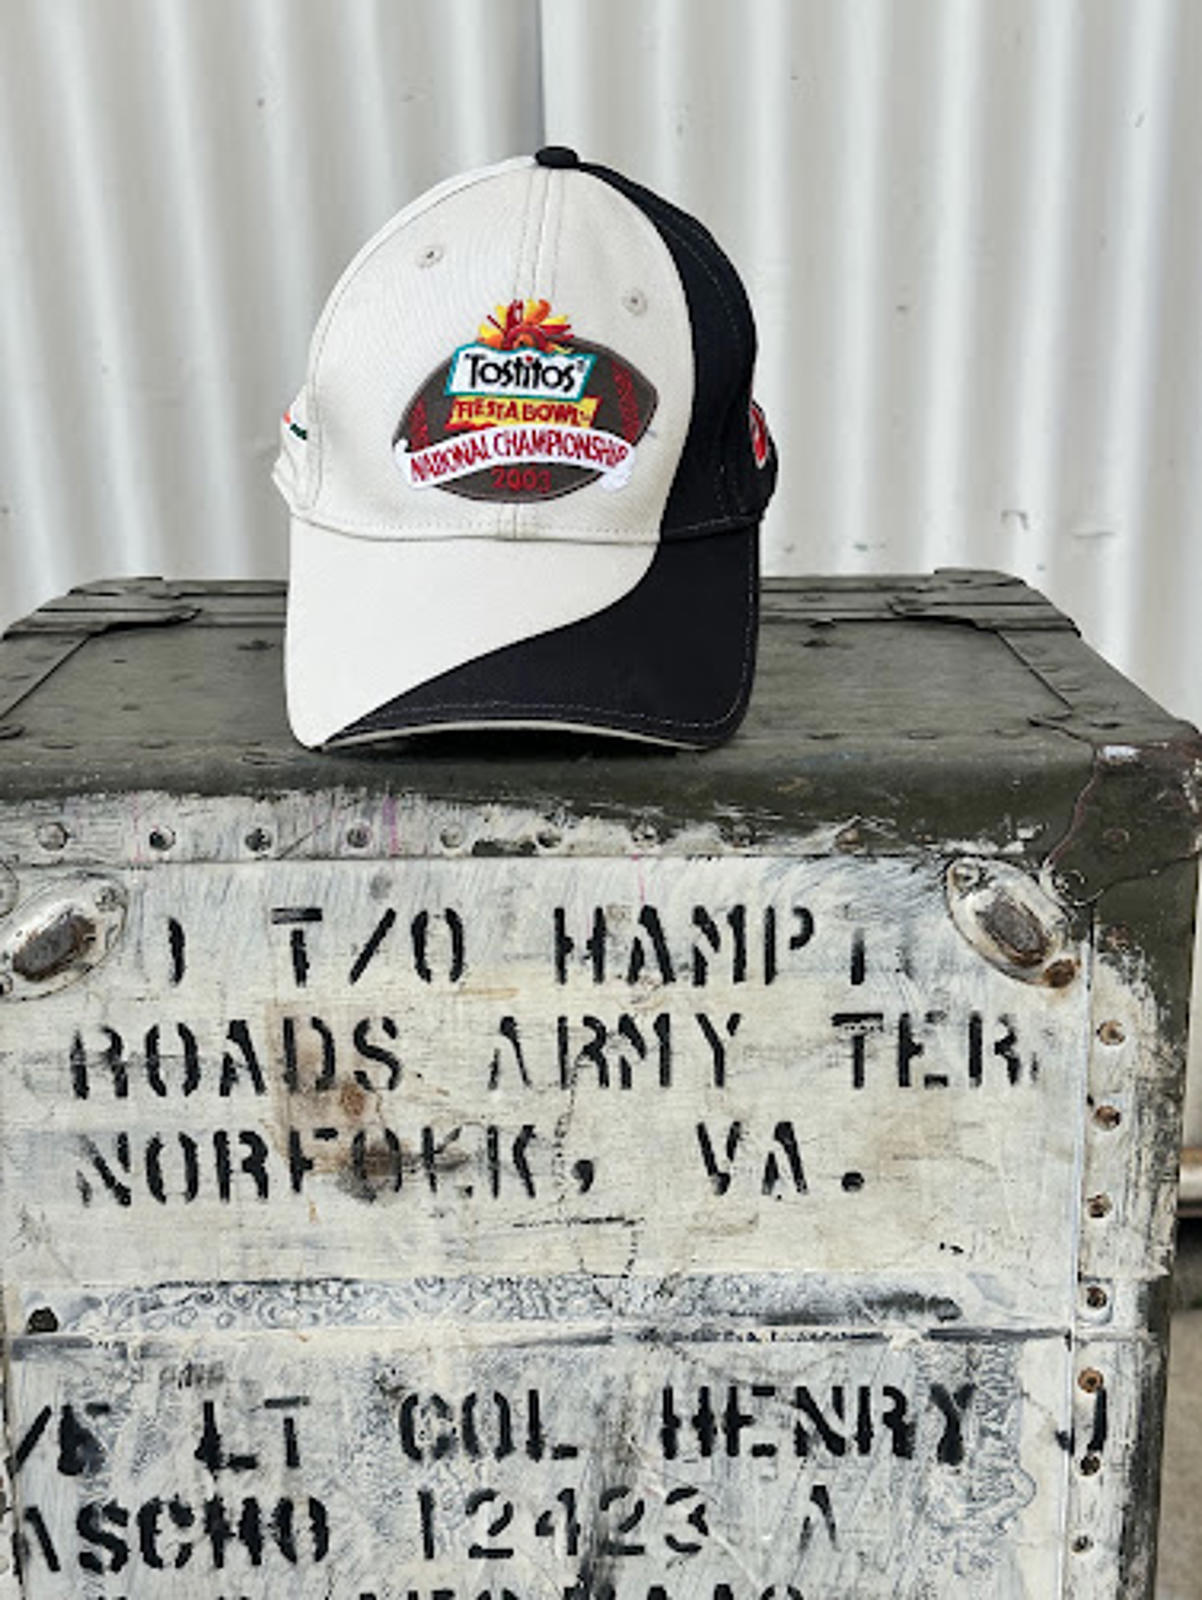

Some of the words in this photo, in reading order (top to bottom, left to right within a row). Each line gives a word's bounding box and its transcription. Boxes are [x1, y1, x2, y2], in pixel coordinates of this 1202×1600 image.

[464, 353, 575, 393] Tostitos
[455, 399, 519, 421] FIESTA
[410, 434, 491, 482] NATIONAL
[493, 429, 629, 468] CHAMPIONSHIP
[490, 467, 551, 492] 2003
[69, 1016, 400, 1100] ROADS
[489, 1012, 741, 1090] ARMY
[194, 1395, 311, 1472] LT
[399, 1389, 579, 1463] COL
[660, 1384, 974, 1464] HENRY
[418, 1486, 709, 1561] 12423
